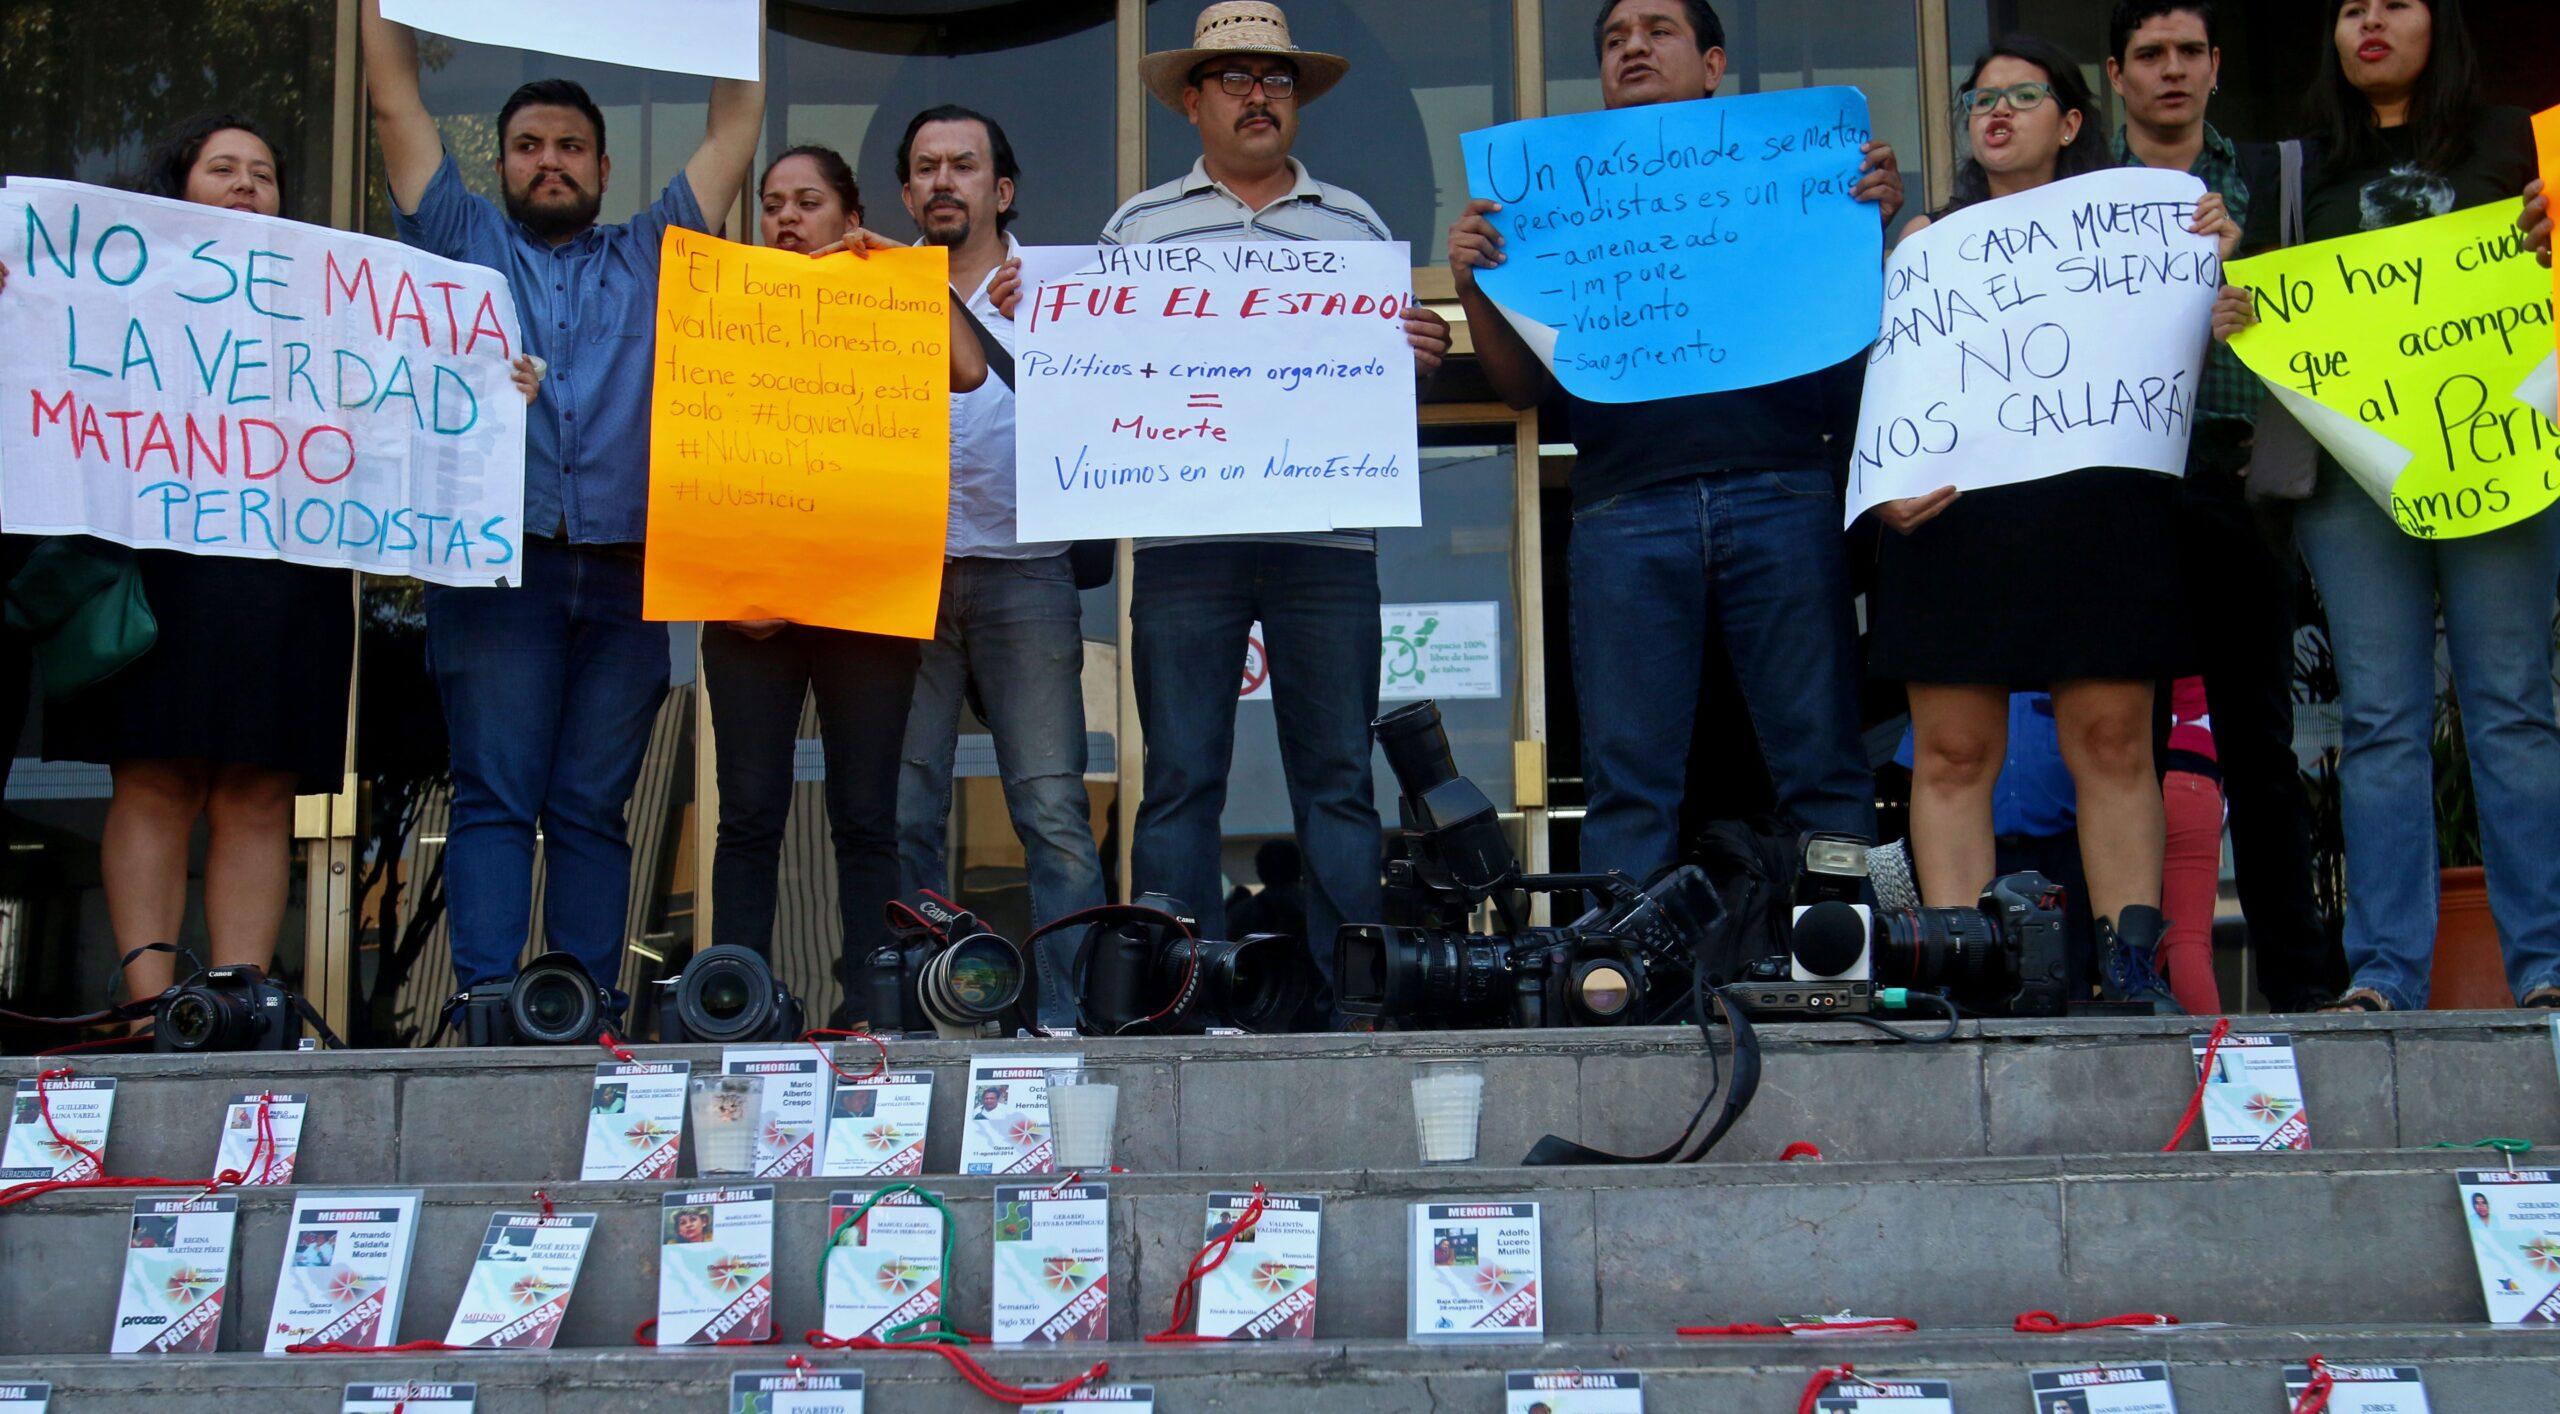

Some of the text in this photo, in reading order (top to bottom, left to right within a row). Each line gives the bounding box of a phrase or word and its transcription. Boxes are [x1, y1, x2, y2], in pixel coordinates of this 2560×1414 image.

[1488, 138, 1554, 204] Un
[1575, 142, 1638, 206] país
[1642, 110, 1744, 176] donde
[1761, 132, 1793, 161] se
[1513, 189, 1687, 240] periodistas
[1699, 188, 1729, 207] es
[1744, 180, 1778, 206] un
[1959, 220, 2056, 264] CADA
[2072, 202, 2197, 250] MUERTE
[1076, 245, 1346, 275] JAVIER VALDEZ:
[25, 203, 510, 361] NO SE MATA
[744, 263, 800, 300] buen
[1983, 274, 2047, 311] EL
[2056, 251, 2217, 295] SILENCIO
[2337, 254, 2422, 306] hay
[1030, 279, 1139, 333] ¡FUE
[1163, 287, 1219, 318] EL
[668, 302, 941, 357] valiente, honesto, no
[69, 305, 478, 435] LA VERDAD
[666, 344, 734, 385] tiene
[876, 374, 930, 402] está
[1022, 349, 1384, 391] Políticos + crimen organizado
[1956, 322, 2069, 393] NO
[2289, 351, 2350, 396] que
[2359, 379, 2399, 422] al
[31, 388, 354, 485] MATANDO
[1112, 415, 1227, 441] Muerte
[1858, 401, 1958, 494] NOS
[1055, 445, 1168, 490] Vivimos
[1181, 462, 1206, 480] en
[1220, 462, 1244, 480] un
[139, 480, 513, 569] PERIODISTAS
[1430, 641, 1486, 652] espacio 100%
[1430, 653, 1488, 662] libre de humo
[1430, 665, 1470, 673] de tabaco
[616, 1064, 674, 1074] MEMORIAL
[746, 1063, 801, 1072] MEMORIAL
[1018, 1189, 1088, 1200] MEMORIAL
[2477, 1172, 2550, 1182] MEMORIAL
[154, 1201, 219, 1212] MEMORIAL
[317, 1211, 381, 1221] MEMORIAL
[686, 1190, 755, 1204] MEMORIAL
[1448, 1207, 1514, 1217] MEMORIAL
[350, 1231, 391, 1239] Armando
[508, 1217, 573, 1227] MEMORIAL
[353, 1240, 389, 1248] Saldaña
[122, 1314, 167, 1328] proceso
[155, 1298, 221, 1352] PRENSA
[317, 1298, 382, 1344] PRENSA
[463, 1313, 506, 1321] MILENIO
[490, 1302, 562, 1347] PRENSA
[704, 1284, 770, 1341] PRENSA
[1041, 1286, 1107, 1342] PRENSA
[1247, 1289, 1315, 1338] PRENSA
[372, 1386, 454, 1398] MEMORIAL
[760, 1376, 842, 1390] MEMORIAL
[1533, 1375, 1618, 1388] MEMORIAL
[1838, 1385, 1924, 1397] MEMORIAL
[2058, 1368, 2145, 1386] MEMORIAL
